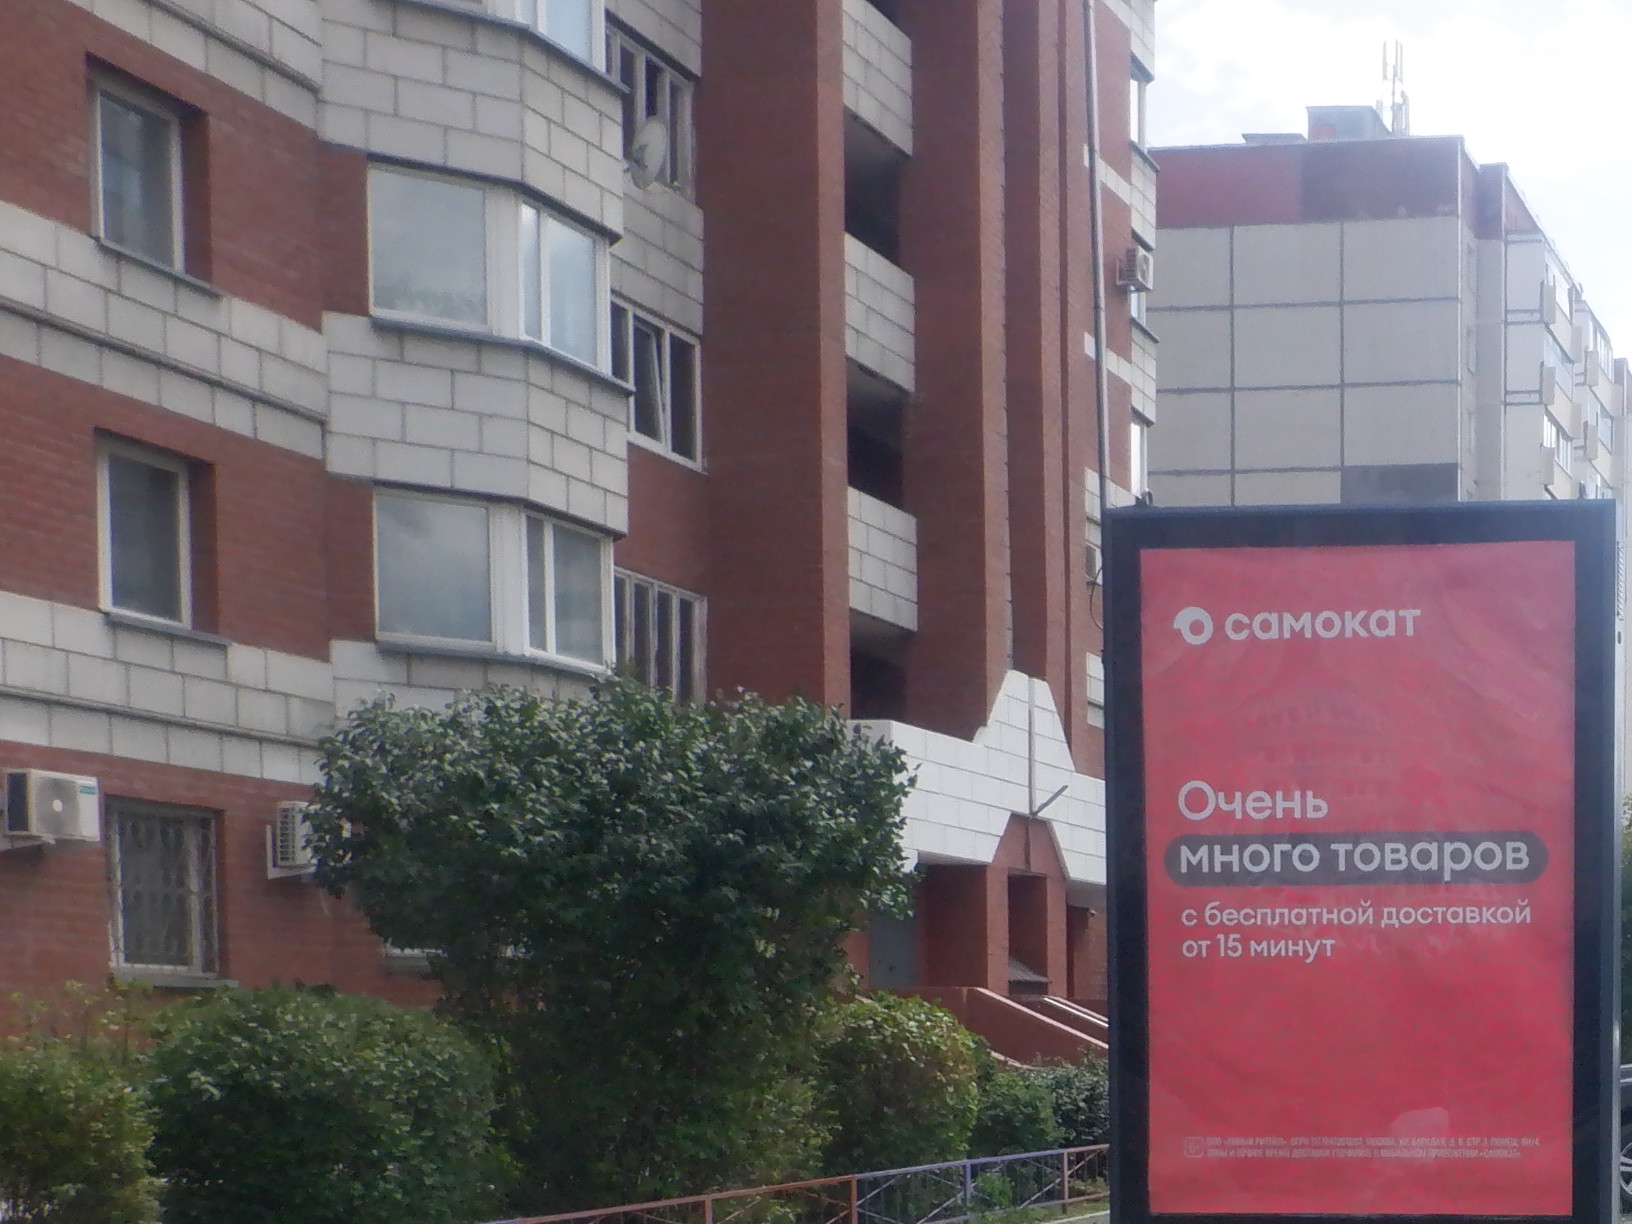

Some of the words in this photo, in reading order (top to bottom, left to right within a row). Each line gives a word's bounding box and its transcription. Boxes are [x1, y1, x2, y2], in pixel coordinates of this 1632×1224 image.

[1224, 608, 1421, 641] самокат
[1177, 780, 1329, 821] Очень
[1179, 842, 1321, 874] много
[1329, 841, 1530, 882] товаров
[1181, 908, 1198, 926] с
[1204, 899, 1374, 927] бесплатной
[1380, 898, 1532, 929] доставкой
[1181, 939, 1212, 958] от
[1216, 933, 1243, 958] 15
[1250, 938, 1337, 964] минут
